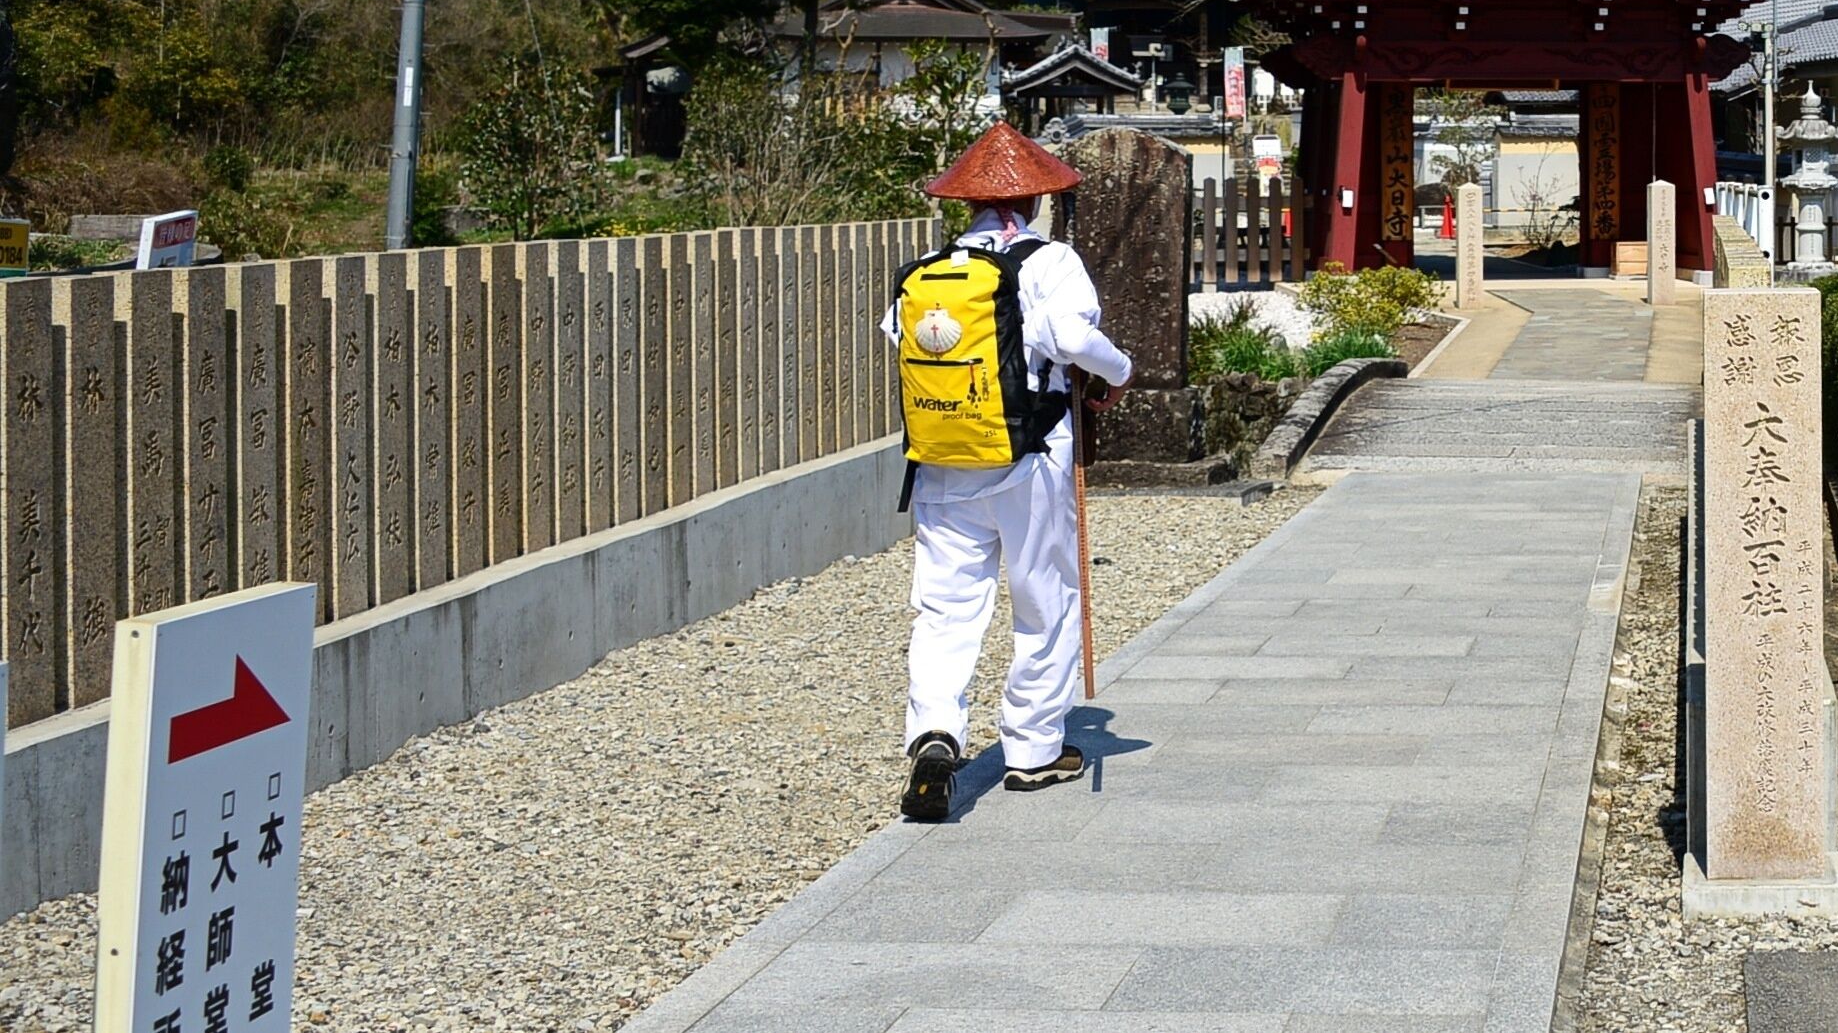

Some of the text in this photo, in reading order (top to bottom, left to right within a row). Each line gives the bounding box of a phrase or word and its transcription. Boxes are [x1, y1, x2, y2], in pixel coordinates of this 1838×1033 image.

[1720, 313, 1757, 387] 感謝
[1769, 314, 1806, 387] 報恩
[942, 413, 982, 421] proof bag
[203, 832, 240, 1033] 大師堂
[249, 812, 284, 1023] 本堂
